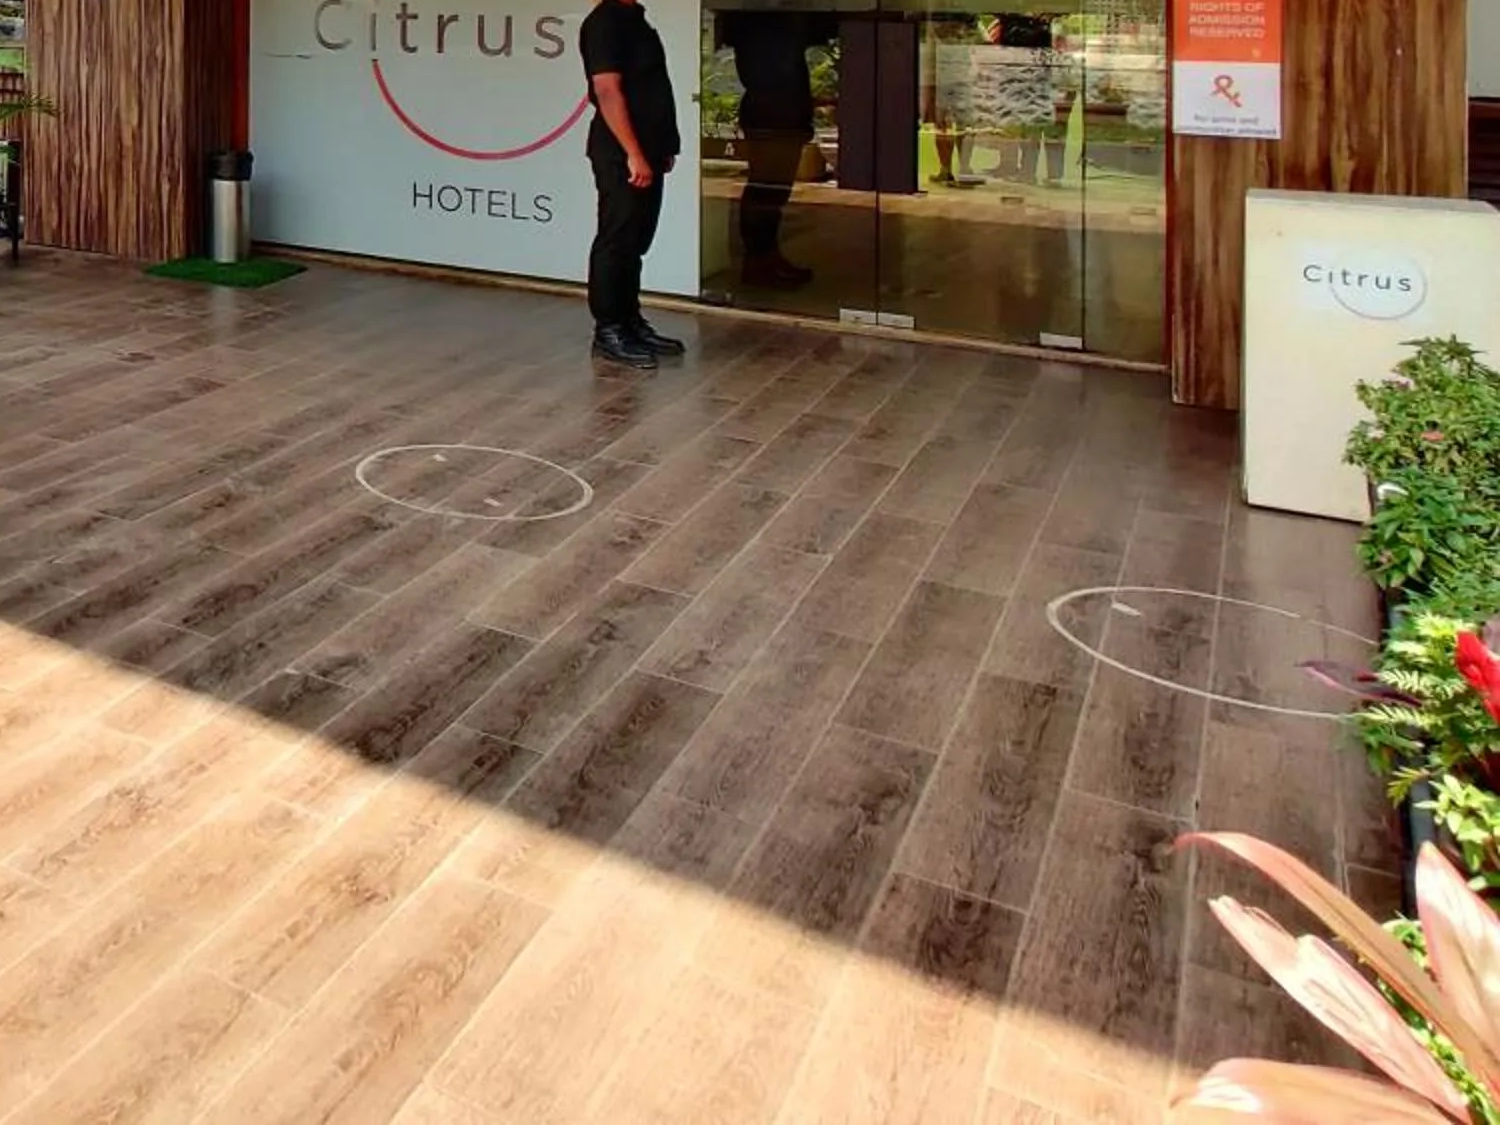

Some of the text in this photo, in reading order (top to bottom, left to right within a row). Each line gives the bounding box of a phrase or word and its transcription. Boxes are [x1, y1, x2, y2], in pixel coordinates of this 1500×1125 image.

[1244, 2, 1264, 12] OF
[1188, 14, 1265, 25] ADMISSION
[412, 182, 553, 223] HOTELS
[1303, 264, 1412, 292] Citrus
